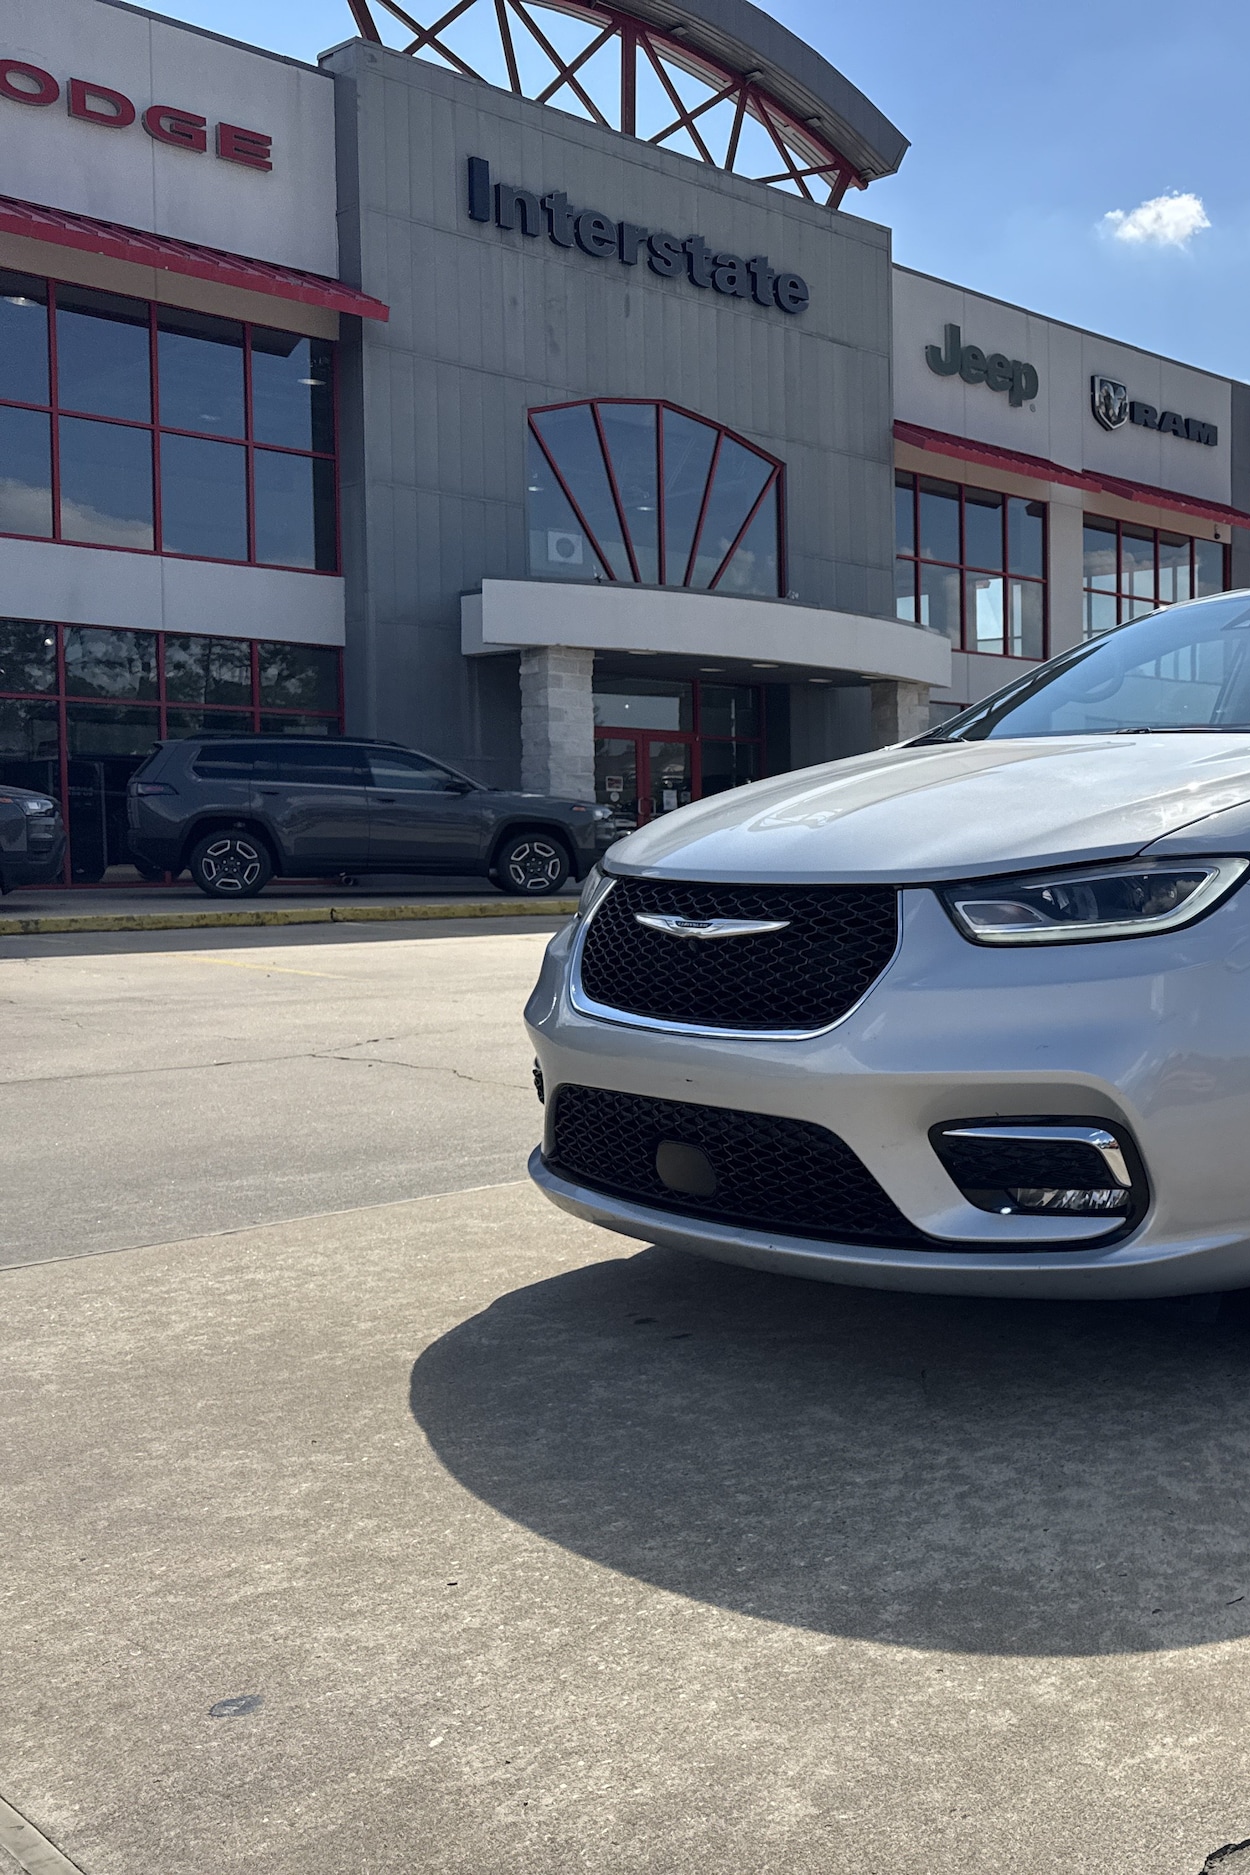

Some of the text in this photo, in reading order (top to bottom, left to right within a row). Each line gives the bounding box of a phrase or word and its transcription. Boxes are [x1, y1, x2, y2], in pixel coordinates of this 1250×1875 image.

[467, 156, 810, 314] Interstate
[925, 323, 1039, 408] Jeep
[1129, 401, 1218, 446] RAM
